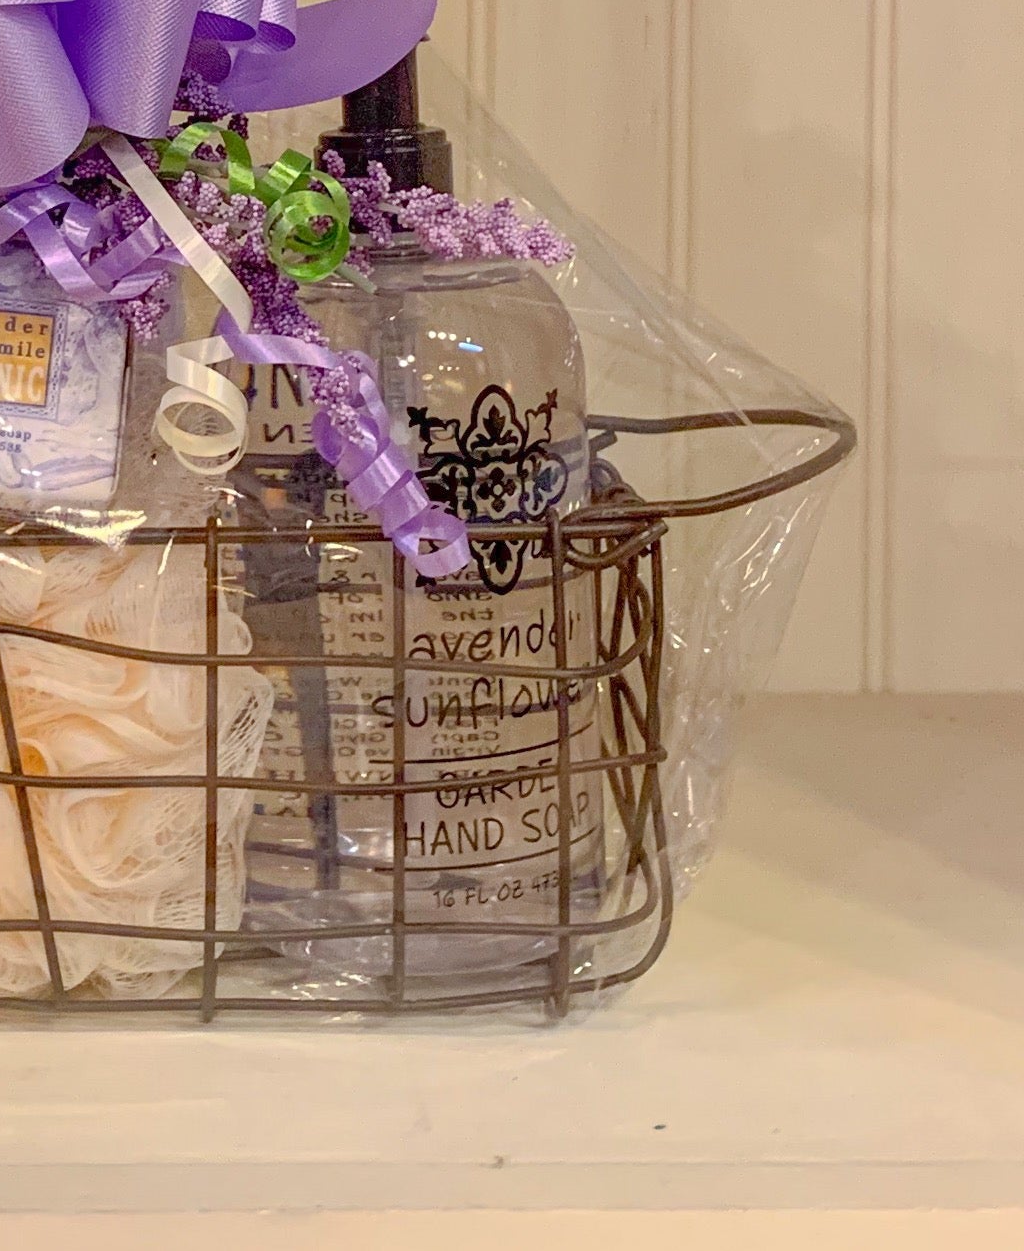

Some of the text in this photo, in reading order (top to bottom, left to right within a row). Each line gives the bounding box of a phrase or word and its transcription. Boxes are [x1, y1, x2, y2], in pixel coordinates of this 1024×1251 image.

[0, 429, 32, 444] soap
[408, 608, 583, 662] avendr
[371, 672, 584, 730] sunflowe
[435, 757, 557, 809] GARDE
[403, 817, 505, 858] HAND
[433, 889, 455, 909] 16
[464, 886, 490, 906] FL
[497, 880, 525, 902] OZ
